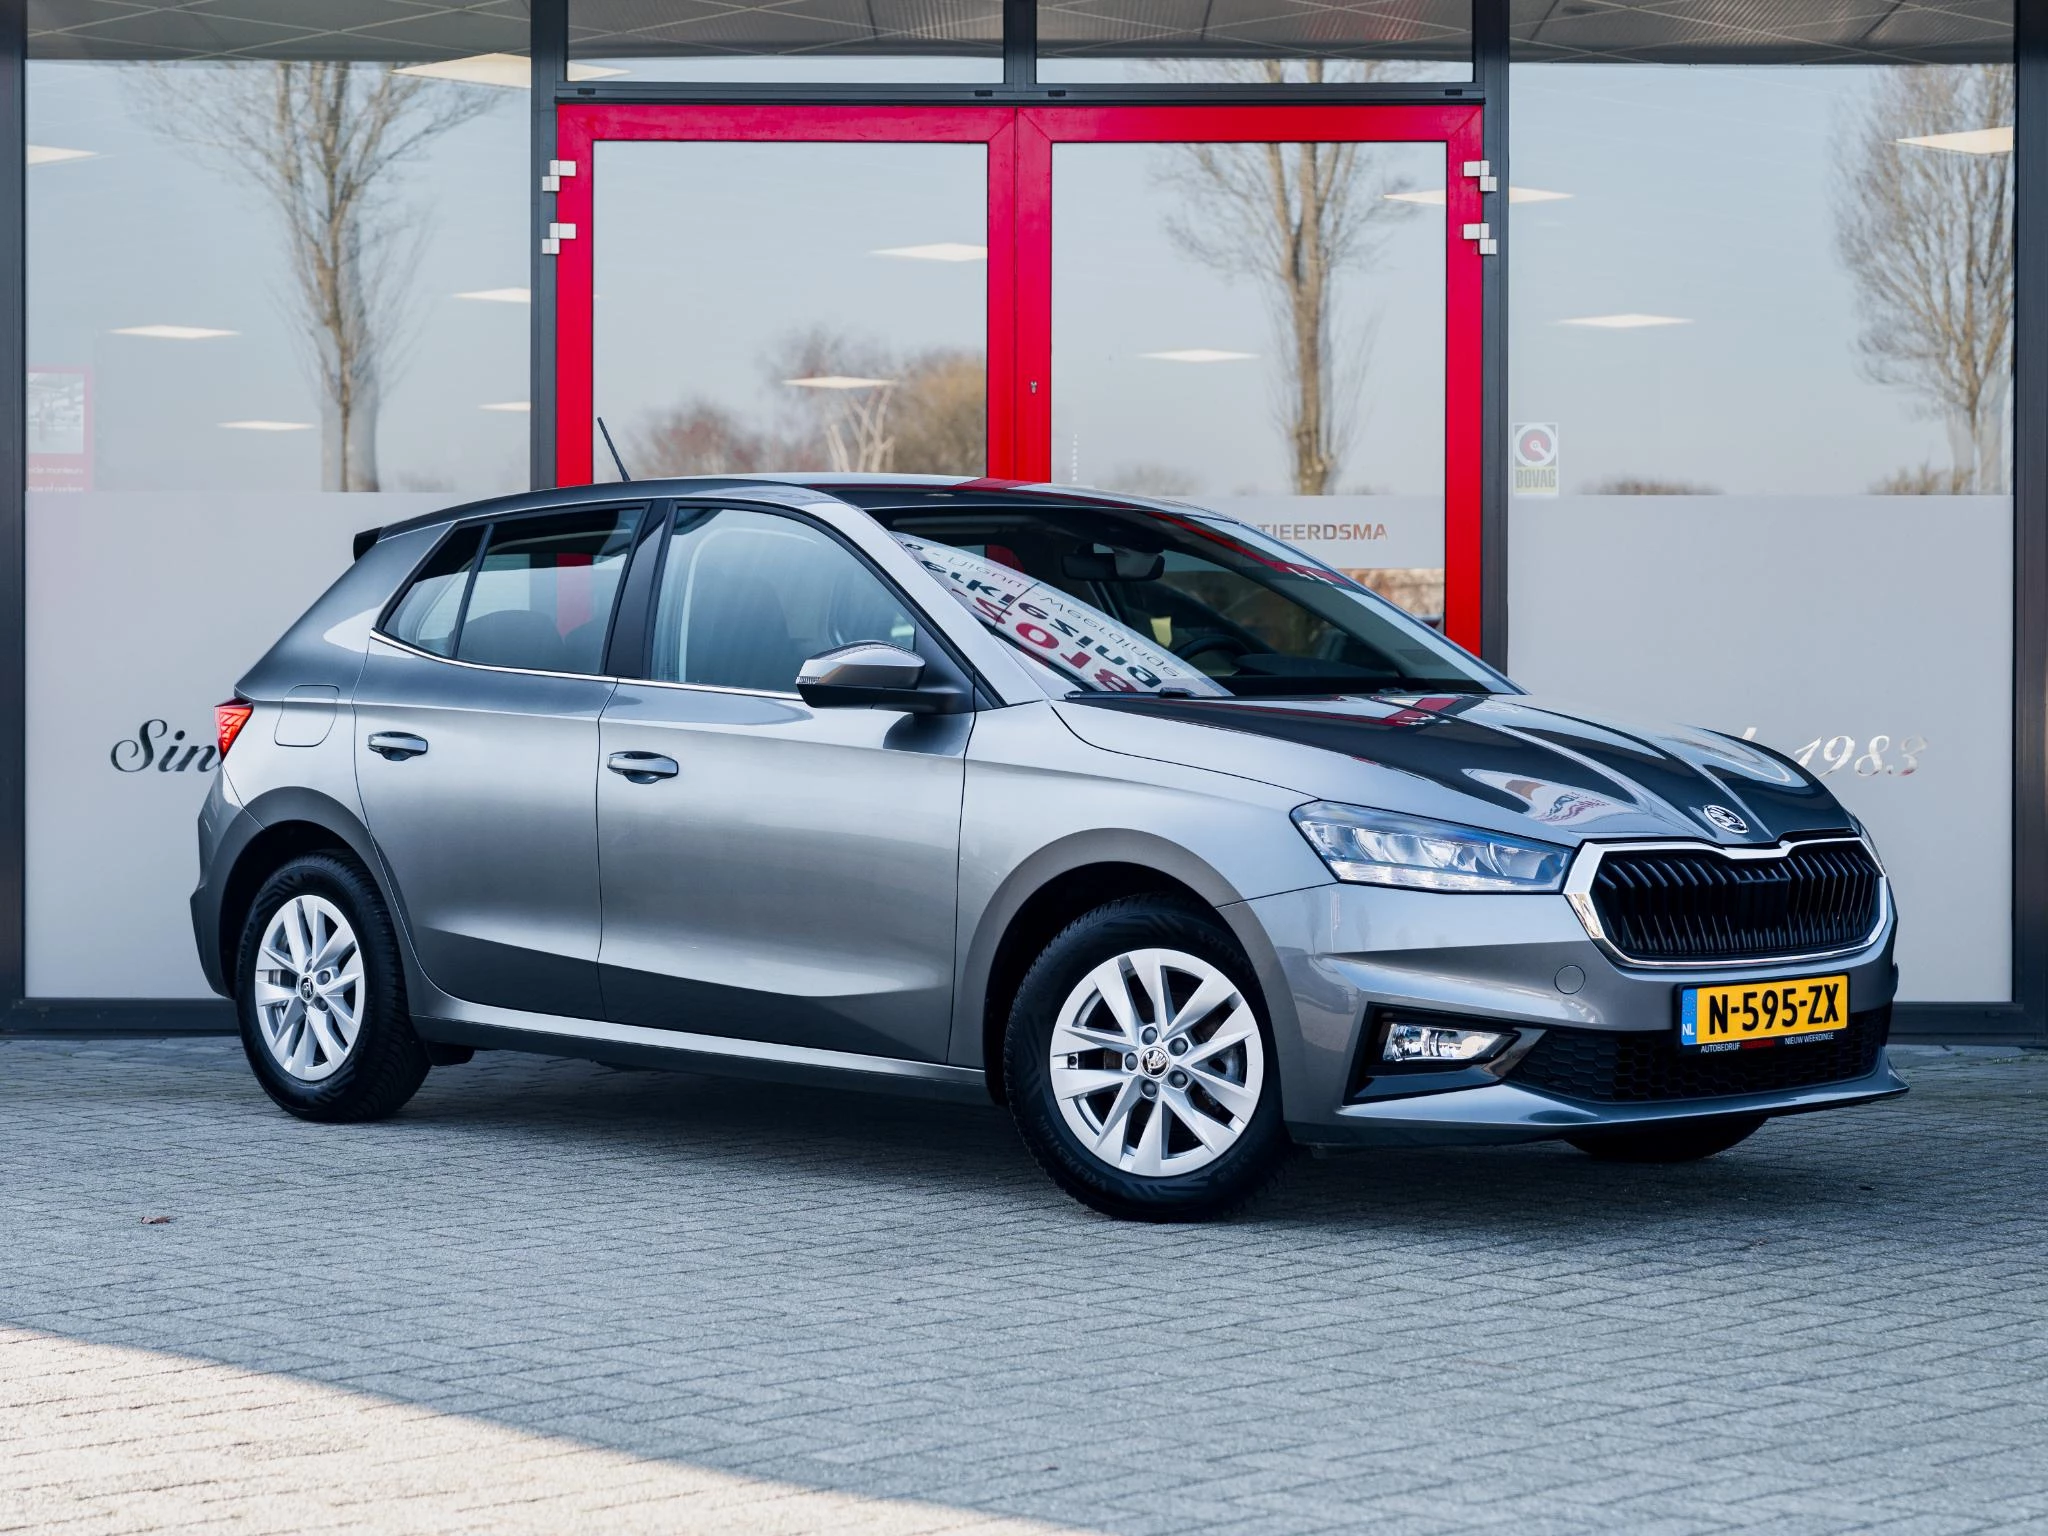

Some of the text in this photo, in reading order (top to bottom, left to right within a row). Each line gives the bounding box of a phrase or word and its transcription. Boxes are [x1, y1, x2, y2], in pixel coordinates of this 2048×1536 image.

[1516, 468, 1556, 489] BOVAG
[110, 718, 222, 773] Sin
[1682, 983, 1840, 1037] NL N-595-ZX
[1784, 1034, 1804, 1046] NIEUW
[1804, 1031, 1835, 1044] WEERDINGE
